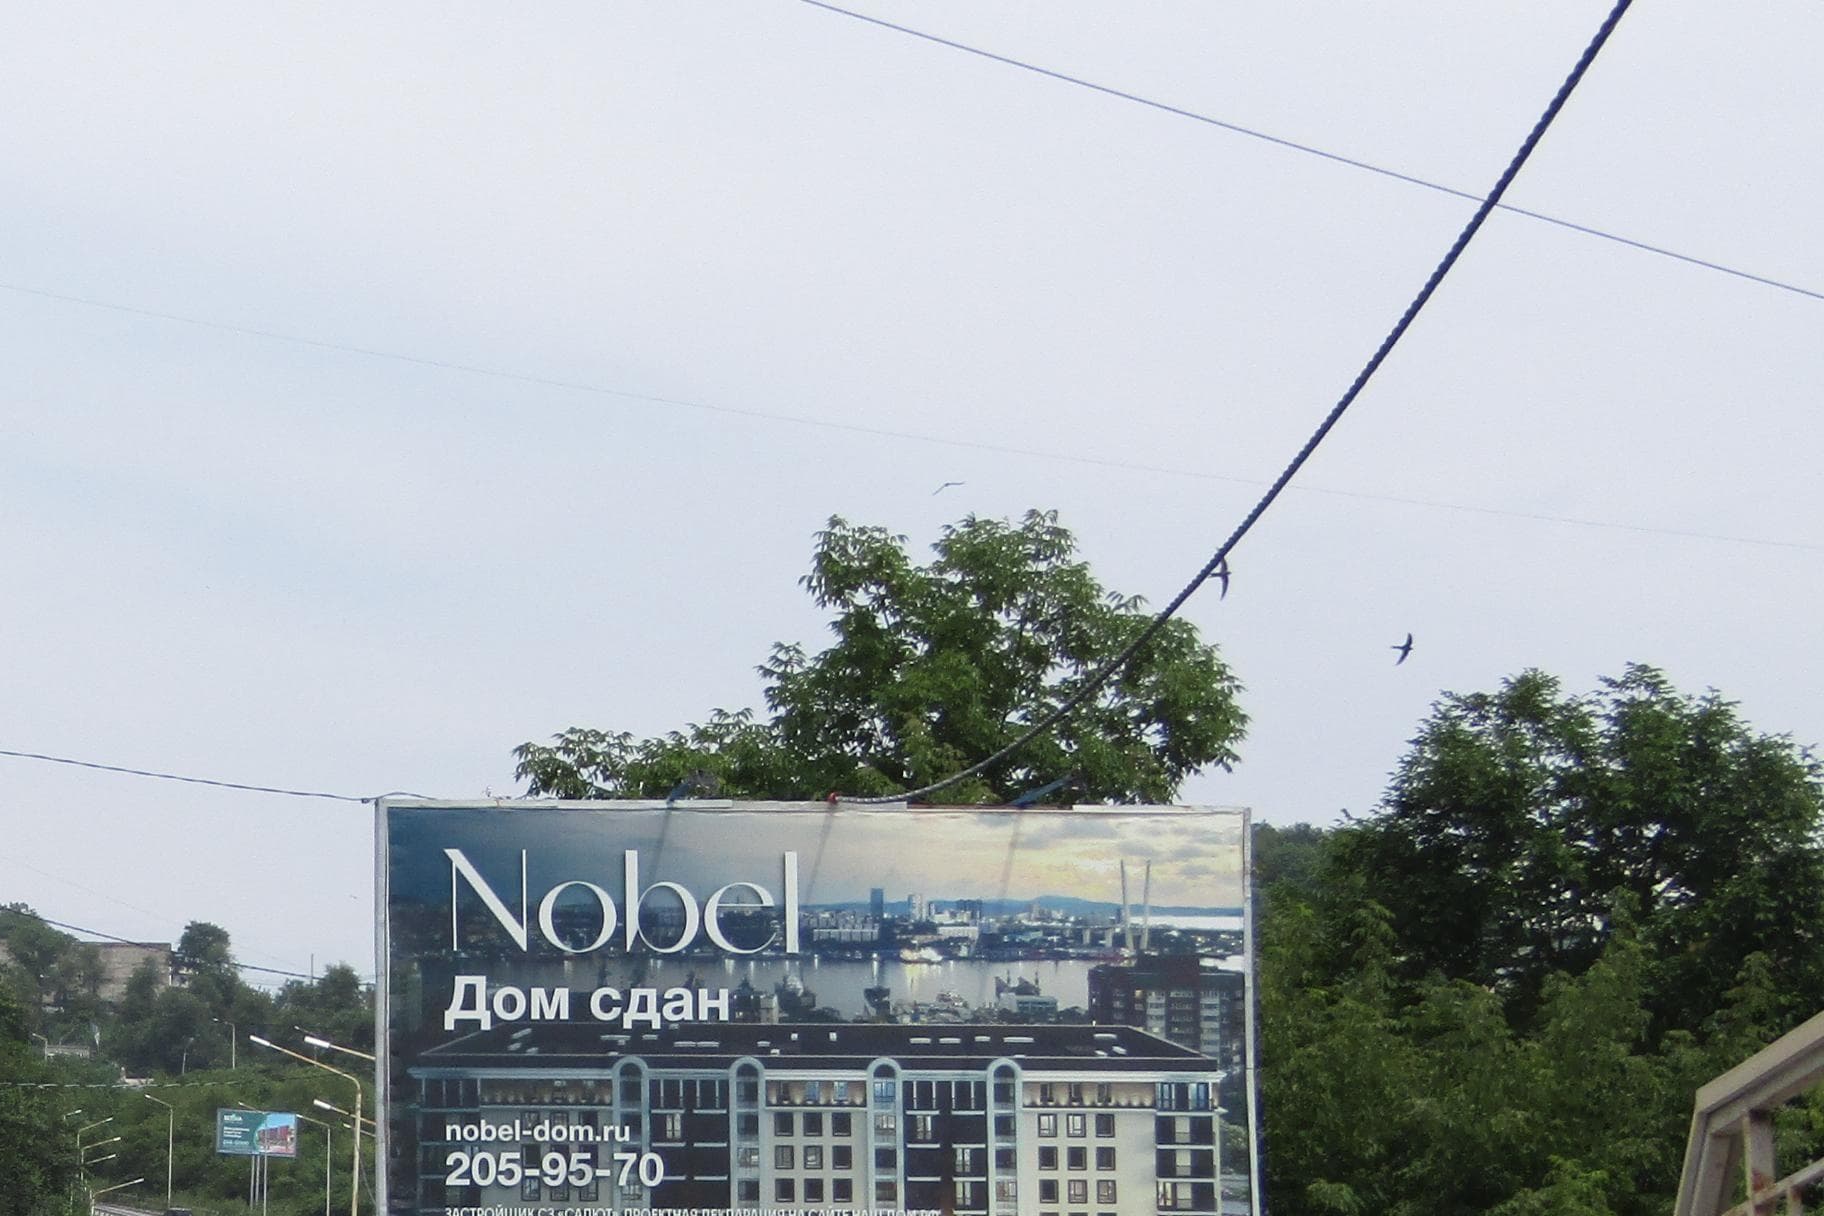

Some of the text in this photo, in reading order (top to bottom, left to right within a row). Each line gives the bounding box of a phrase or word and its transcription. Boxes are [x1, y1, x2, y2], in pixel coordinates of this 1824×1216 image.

[444, 849, 799, 955] Nobel
[444, 974, 730, 1030] Дом сдан
[445, 1119, 630, 1142] nobel-dom.ru
[445, 1151, 665, 1187] 205-95-70
